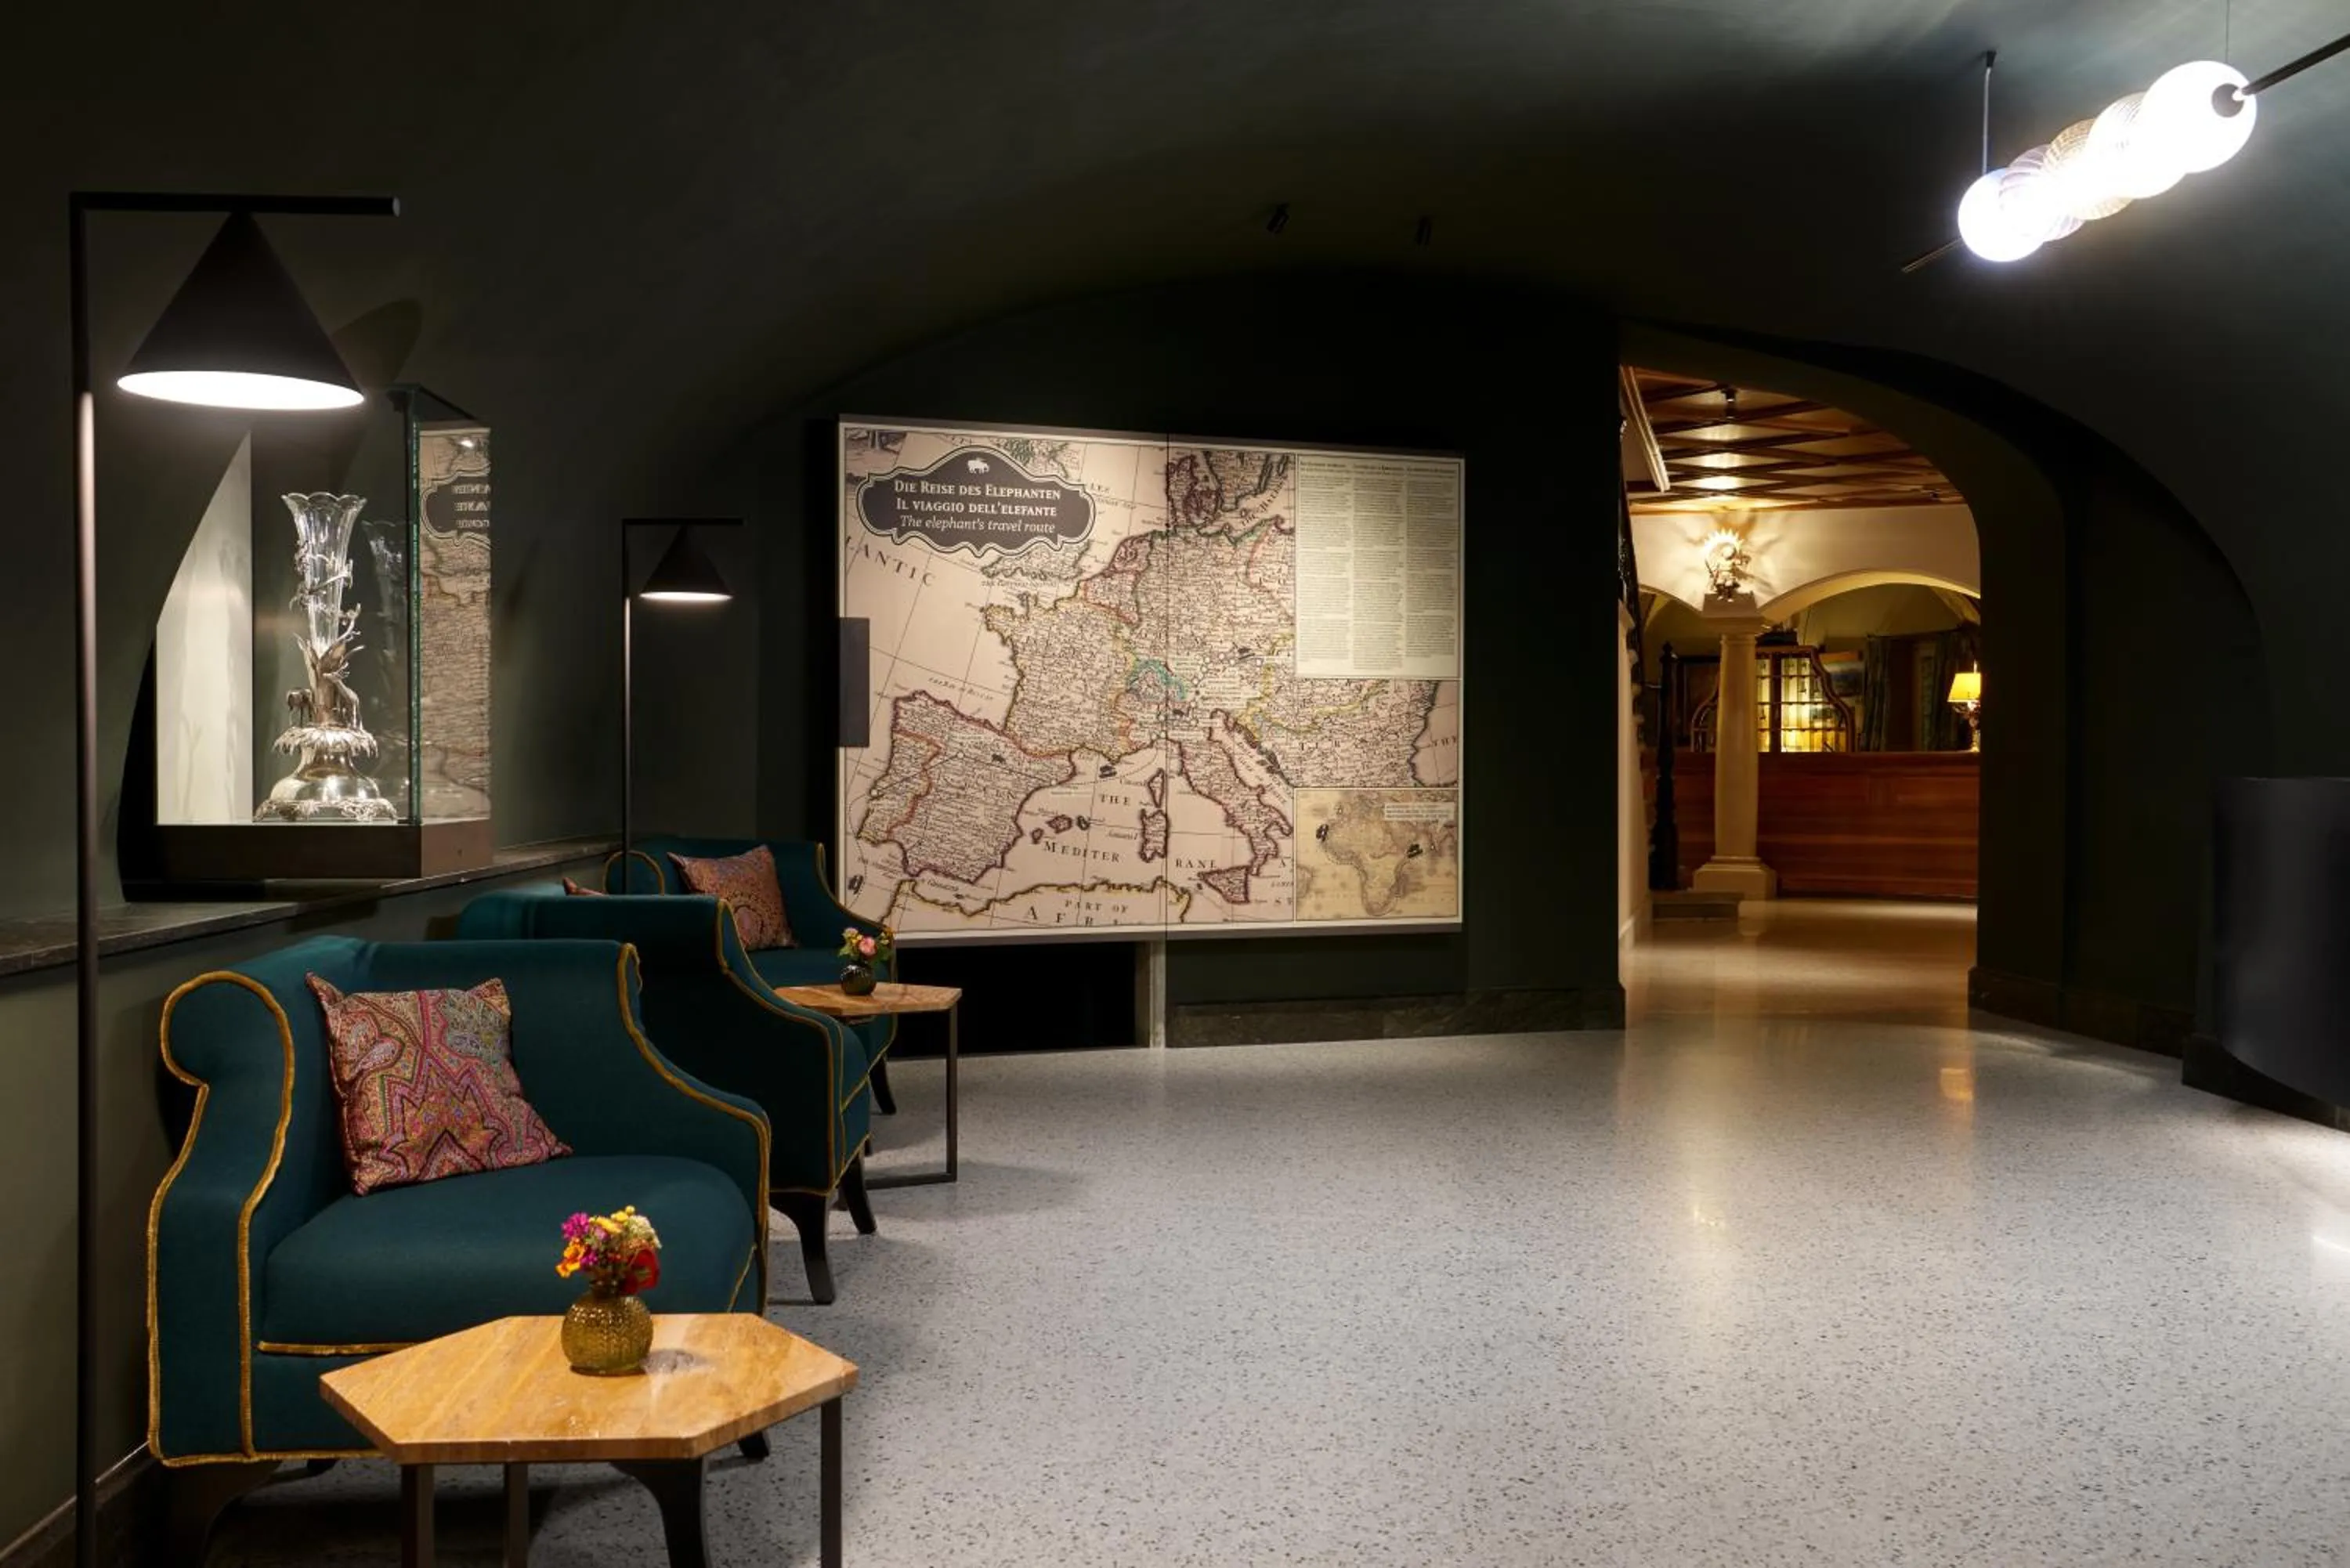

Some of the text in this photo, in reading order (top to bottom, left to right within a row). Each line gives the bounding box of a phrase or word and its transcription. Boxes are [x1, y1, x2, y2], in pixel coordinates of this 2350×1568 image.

[895, 479, 916, 493] DIE
[920, 480, 955, 494] REISE
[985, 483, 1061, 500] ELEPHANTEN
[897, 497, 909, 510] IL
[900, 515, 1055, 533] The elephant's travel route
[1100, 793, 1130, 807] THE
